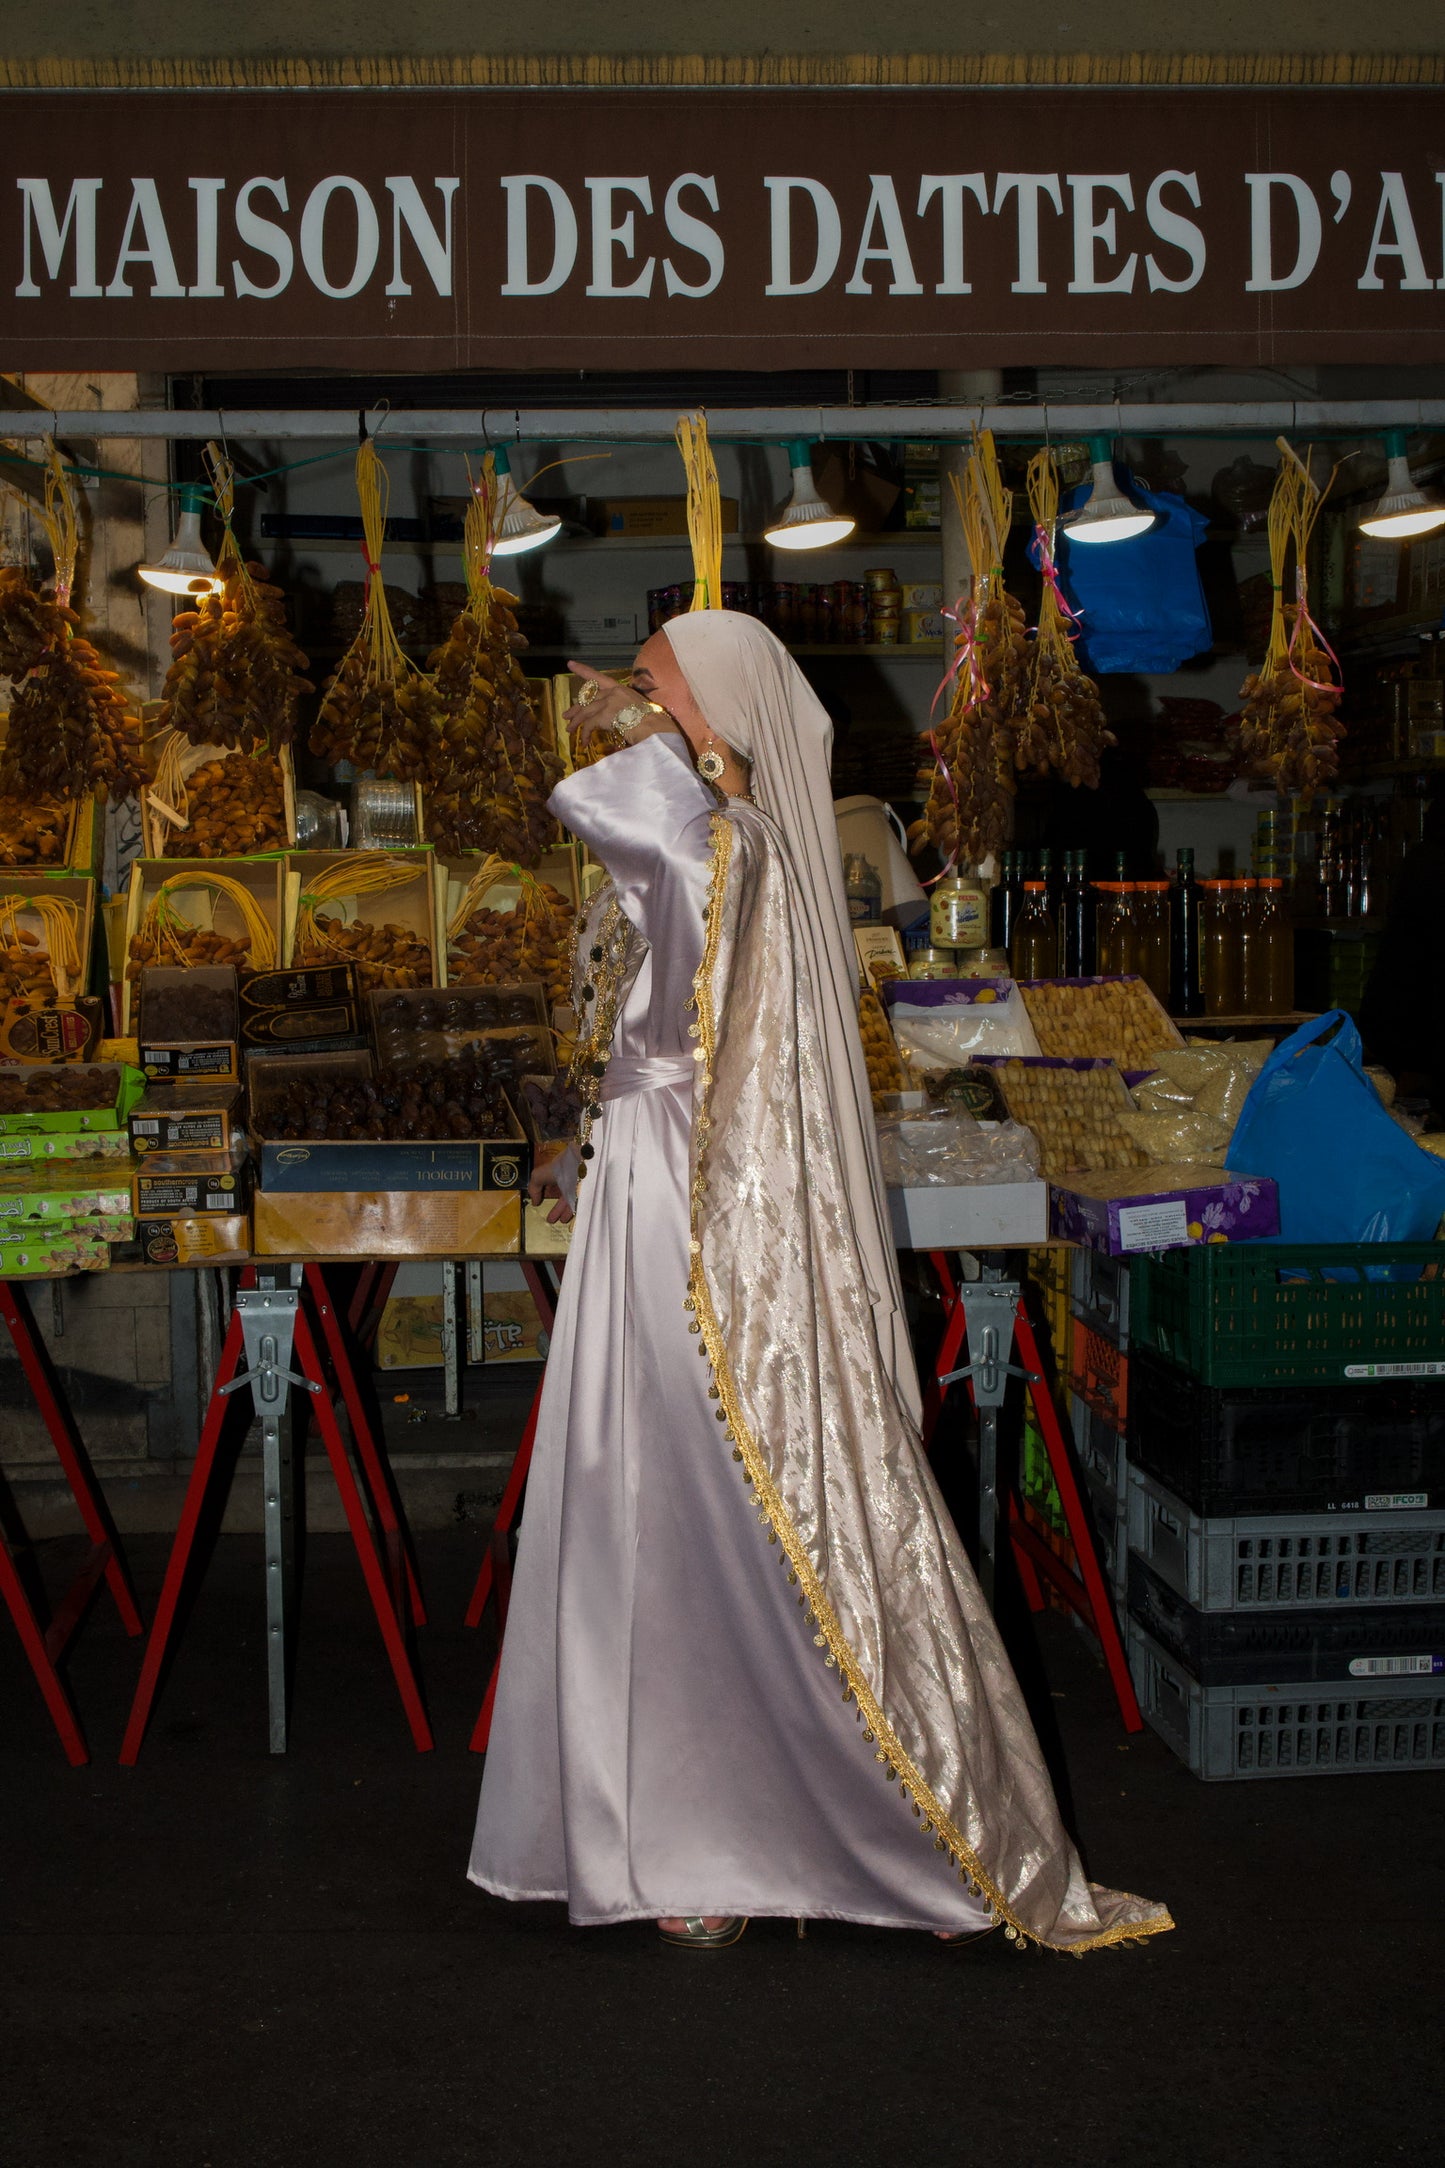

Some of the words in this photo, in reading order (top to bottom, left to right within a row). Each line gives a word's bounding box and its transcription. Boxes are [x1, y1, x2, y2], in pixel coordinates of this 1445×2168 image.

[15, 176, 460, 299] MAISON
[500, 173, 725, 298] DES
[763, 170, 1207, 296] DATTES
[1244, 170, 1445, 293] D'A
[41, 1015, 60, 1055] SunCrest
[0, 1139, 31, 1159] أصيل
[416, 1170, 473, 1181] MEDJOUL
[1392, 1495, 1414, 1504] IFCO
